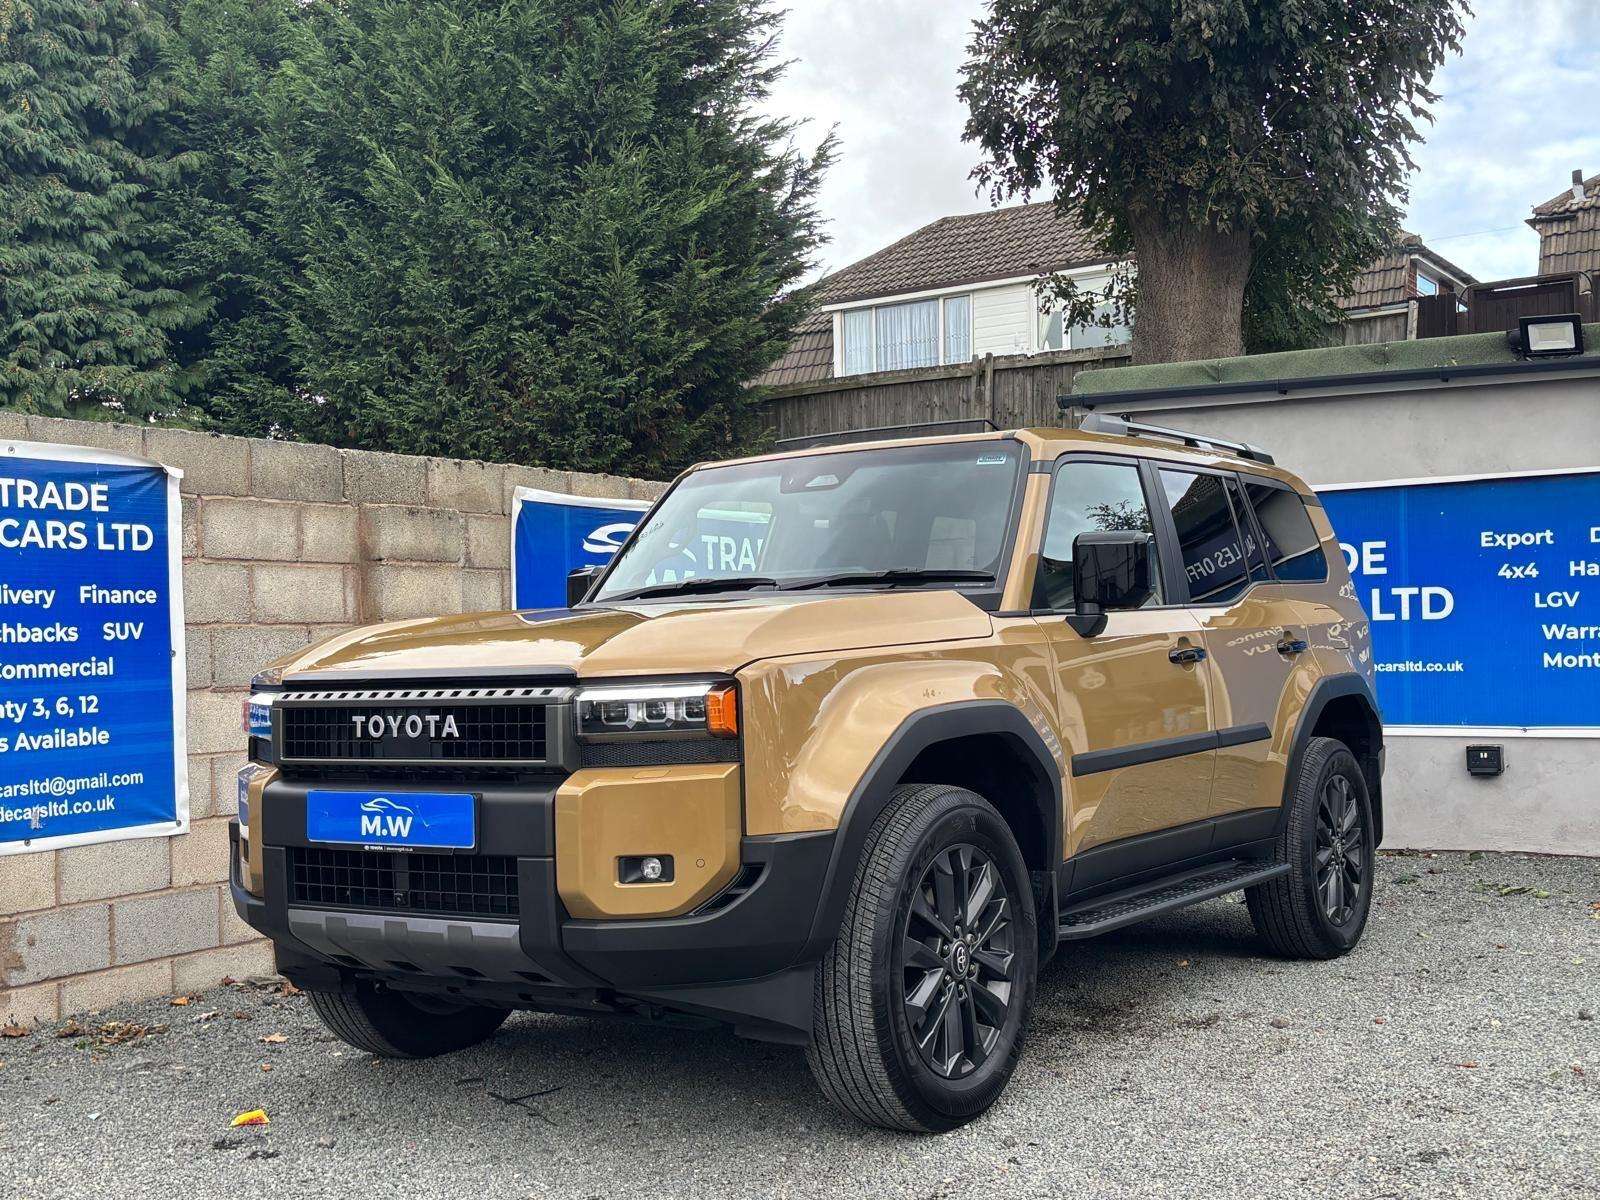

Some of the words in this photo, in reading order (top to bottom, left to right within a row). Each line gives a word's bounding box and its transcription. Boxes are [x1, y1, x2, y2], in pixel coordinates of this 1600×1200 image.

[0, 477, 110, 513] TRADE
[0, 518, 88, 550] CARS
[97, 522, 154, 551] LTD
[1480, 529, 1555, 550] Export
[701, 534, 764, 572] TRA
[1498, 562, 1539, 579] 4x4
[0, 584, 56, 609] ivery
[79, 584, 157, 604] Finance
[1371, 585, 1454, 621] LTD
[1535, 591, 1580, 608] LGV
[0, 622, 79, 643] hbacks
[103, 621, 144, 641] SUV
[1541, 623, 1600, 641] Warr
[0, 656, 114, 680] ommercial
[32, 698, 50, 719] 3,
[55, 696, 74, 717] 6,
[79, 694, 99, 714] 12
[351, 714, 460, 738] TOYOTA
[14, 726, 110, 752] Available
[361, 814, 413, 838] M.W
